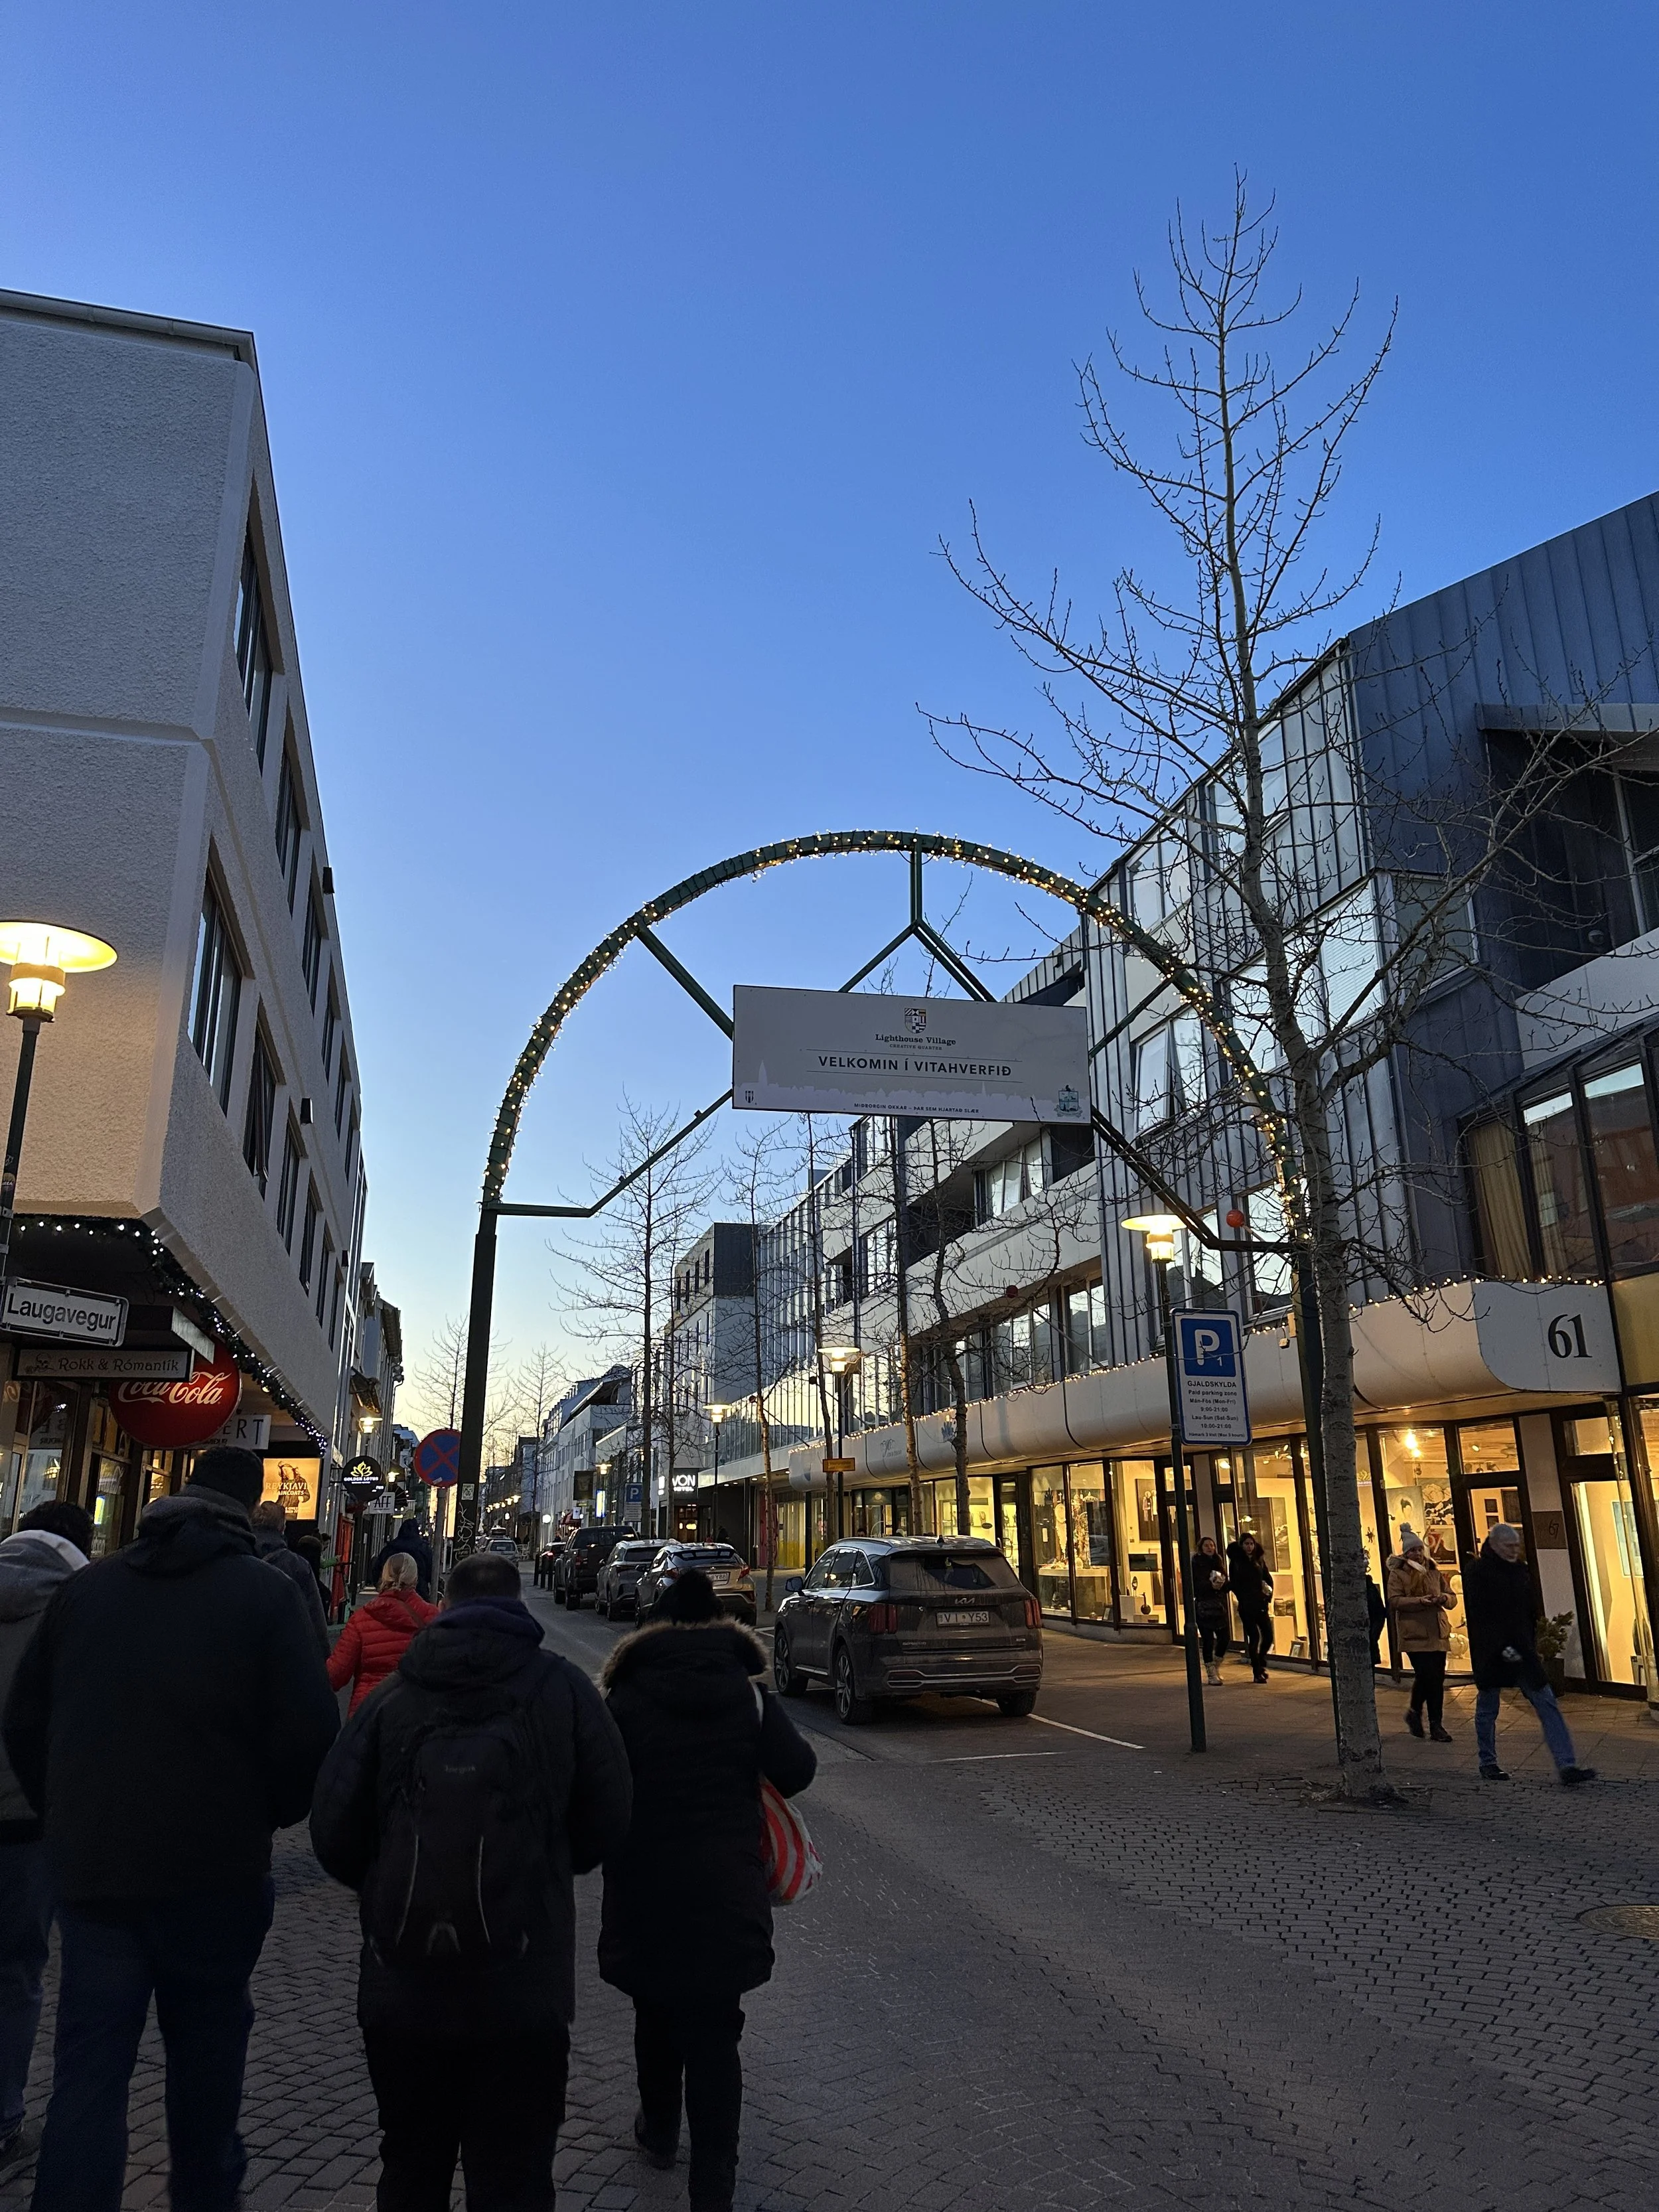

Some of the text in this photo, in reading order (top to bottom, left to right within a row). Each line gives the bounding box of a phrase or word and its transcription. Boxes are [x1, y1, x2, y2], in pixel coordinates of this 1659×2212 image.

[875, 1034, 956, 1045] Lighthouse Village
[818, 1055, 1011, 1076] VELKOMIN Í VITAHVERFIÐ
[7, 1293, 117, 1331] Laugavegur
[1548, 1314, 1592, 1359] 61
[1194, 1329, 1220, 1366] P
[58, 1358, 94, 1371] Rokk
[98, 1358, 109, 1370] &
[672, 1475, 695, 1486] VON
[630, 1488, 639, 1499] P
[1549, 1519, 1559, 1539] 67
